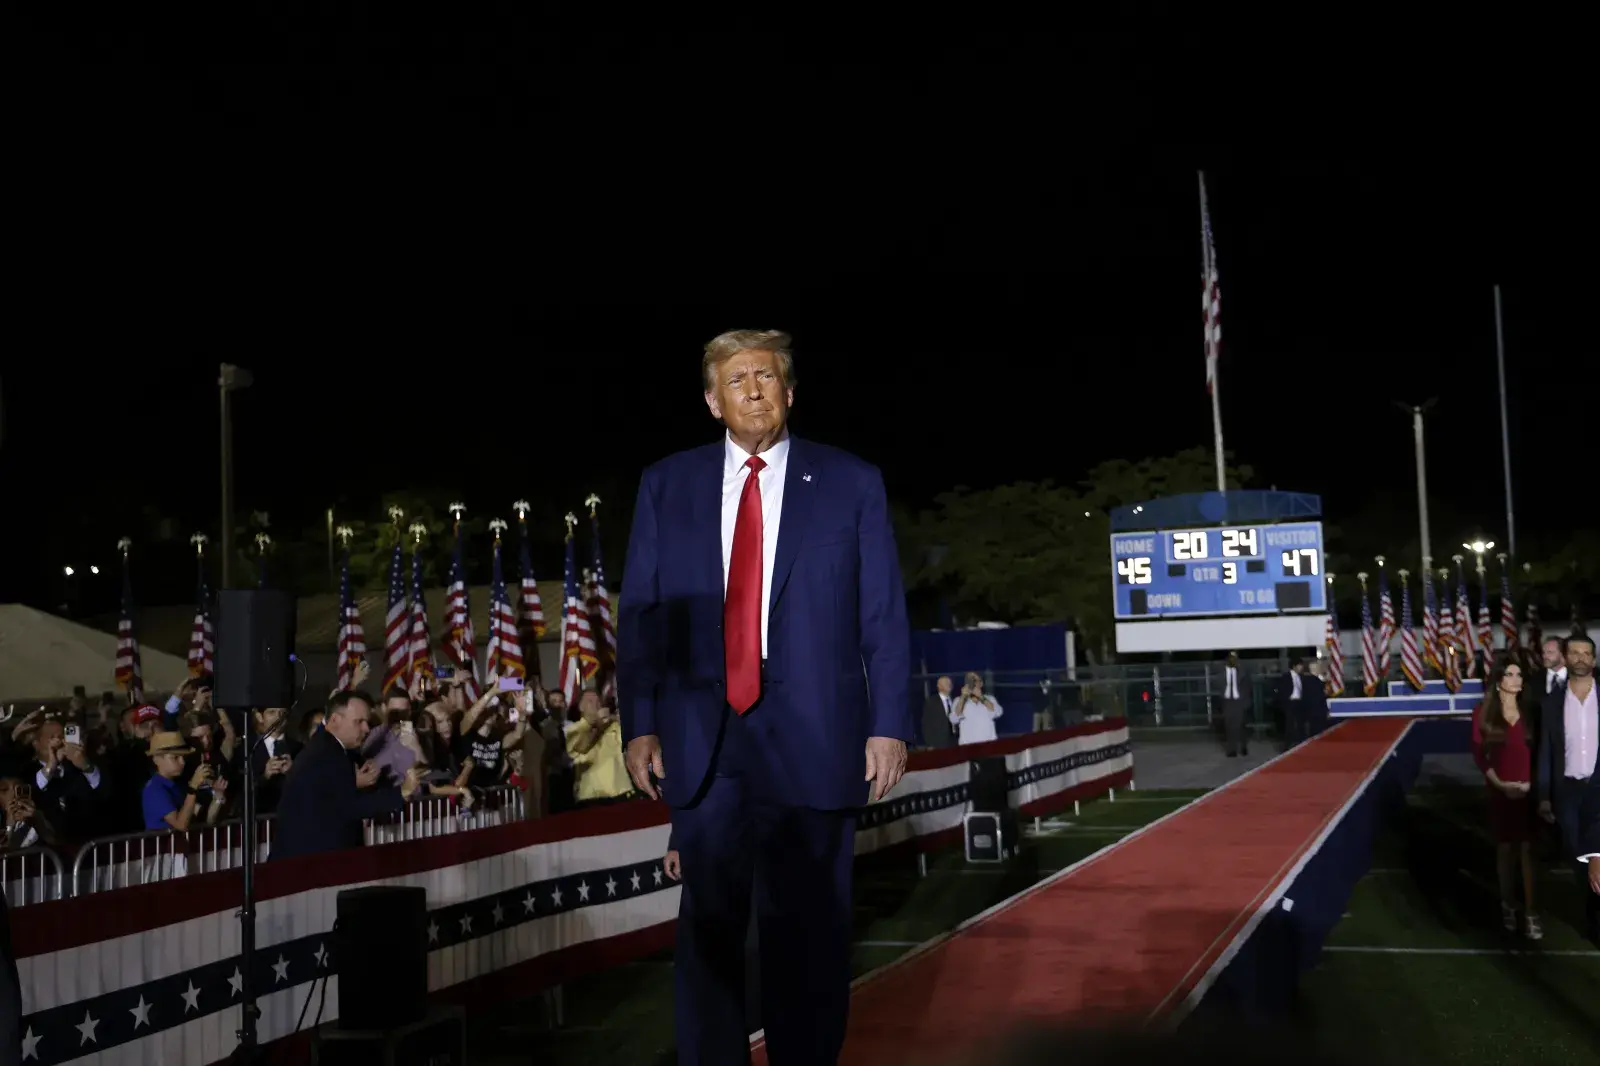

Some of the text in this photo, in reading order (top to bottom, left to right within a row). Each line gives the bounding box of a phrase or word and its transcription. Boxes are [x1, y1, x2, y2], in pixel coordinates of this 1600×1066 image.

[1115, 539, 1154, 553] HOME
[1173, 529, 1258, 559] 20 24
[1266, 530, 1317, 546] VISITOR
[1281, 548, 1319, 576] 47
[1117, 557, 1152, 584] 45
[1193, 567, 1219, 582] QTR
[1222, 562, 1237, 584] 3
[1147, 593, 1182, 608] DOWN
[1239, 589, 1275, 605] TO GO
